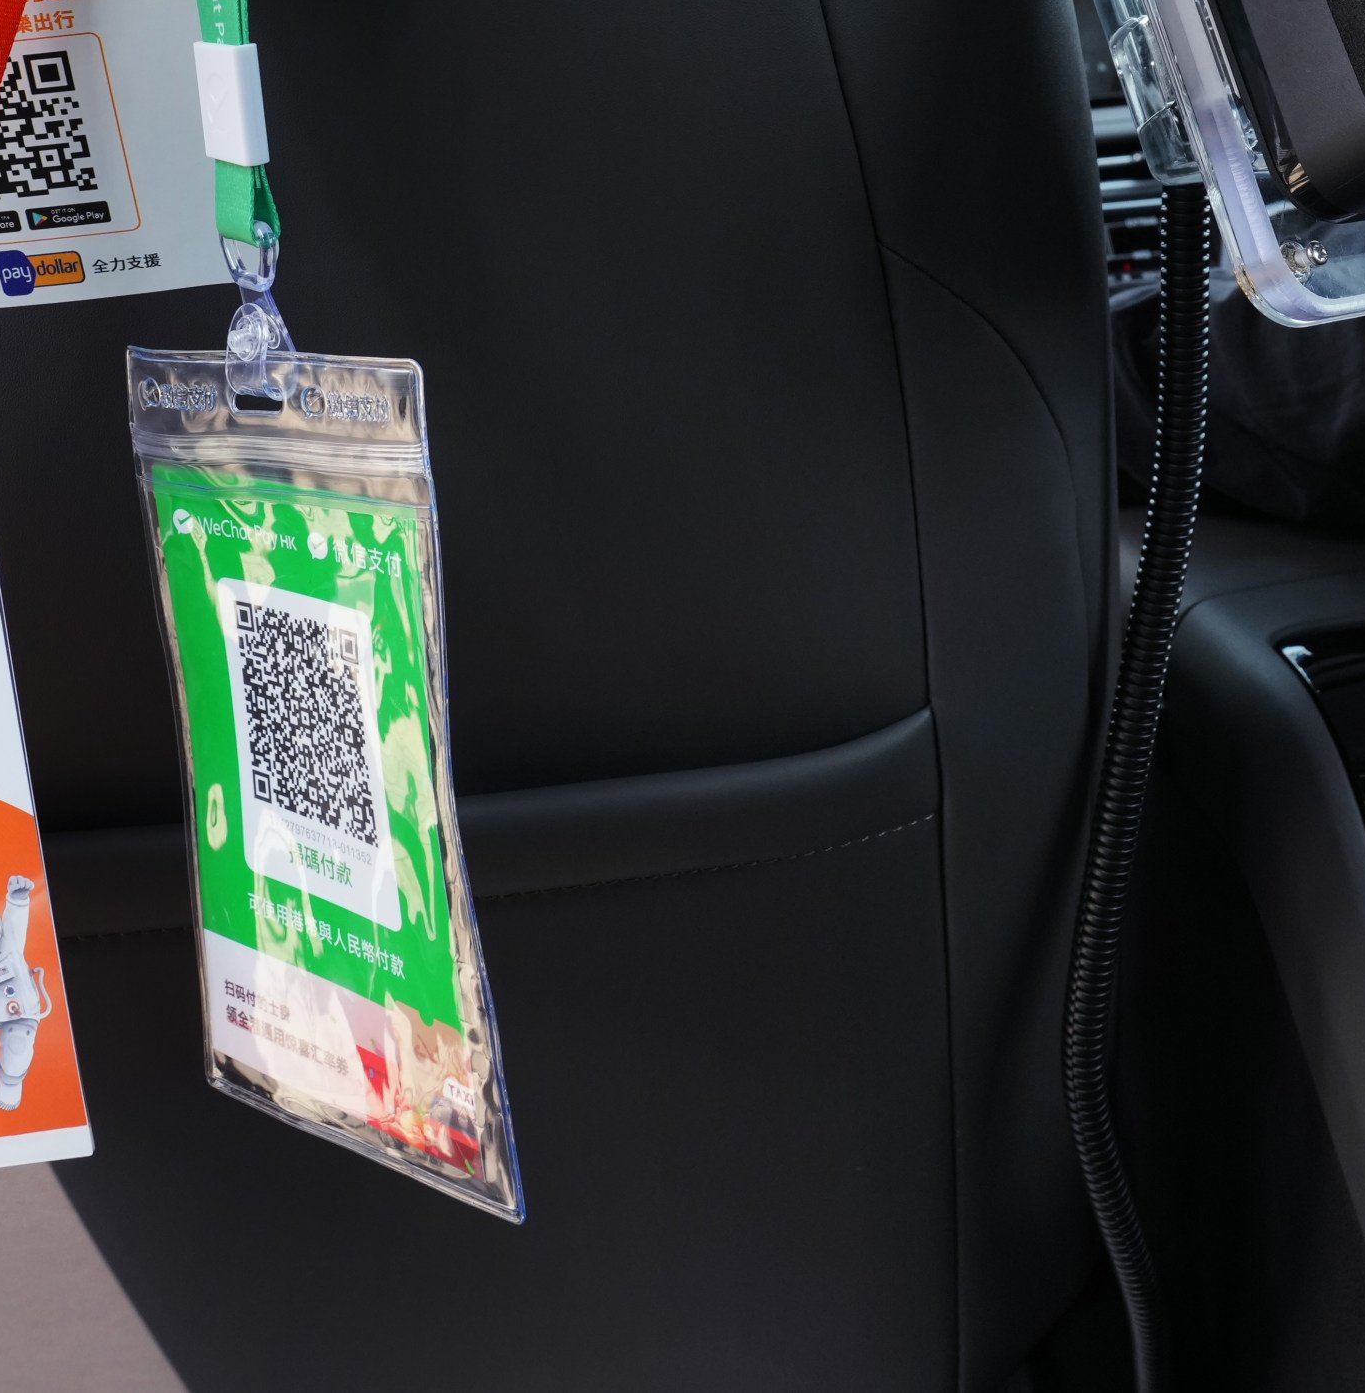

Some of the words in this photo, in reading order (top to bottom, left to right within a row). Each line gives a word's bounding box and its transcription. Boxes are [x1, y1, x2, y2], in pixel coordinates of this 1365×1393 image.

[52, 213, 85, 223] Google
[86, 210, 105, 220] Play
[92, 253, 162, 274] 全力支援
[197, 516, 253, 541] WeChat
[254, 525, 278, 550] Pay
[280, 534, 297, 551] HK
[333, 538, 402, 577] 微信支付
